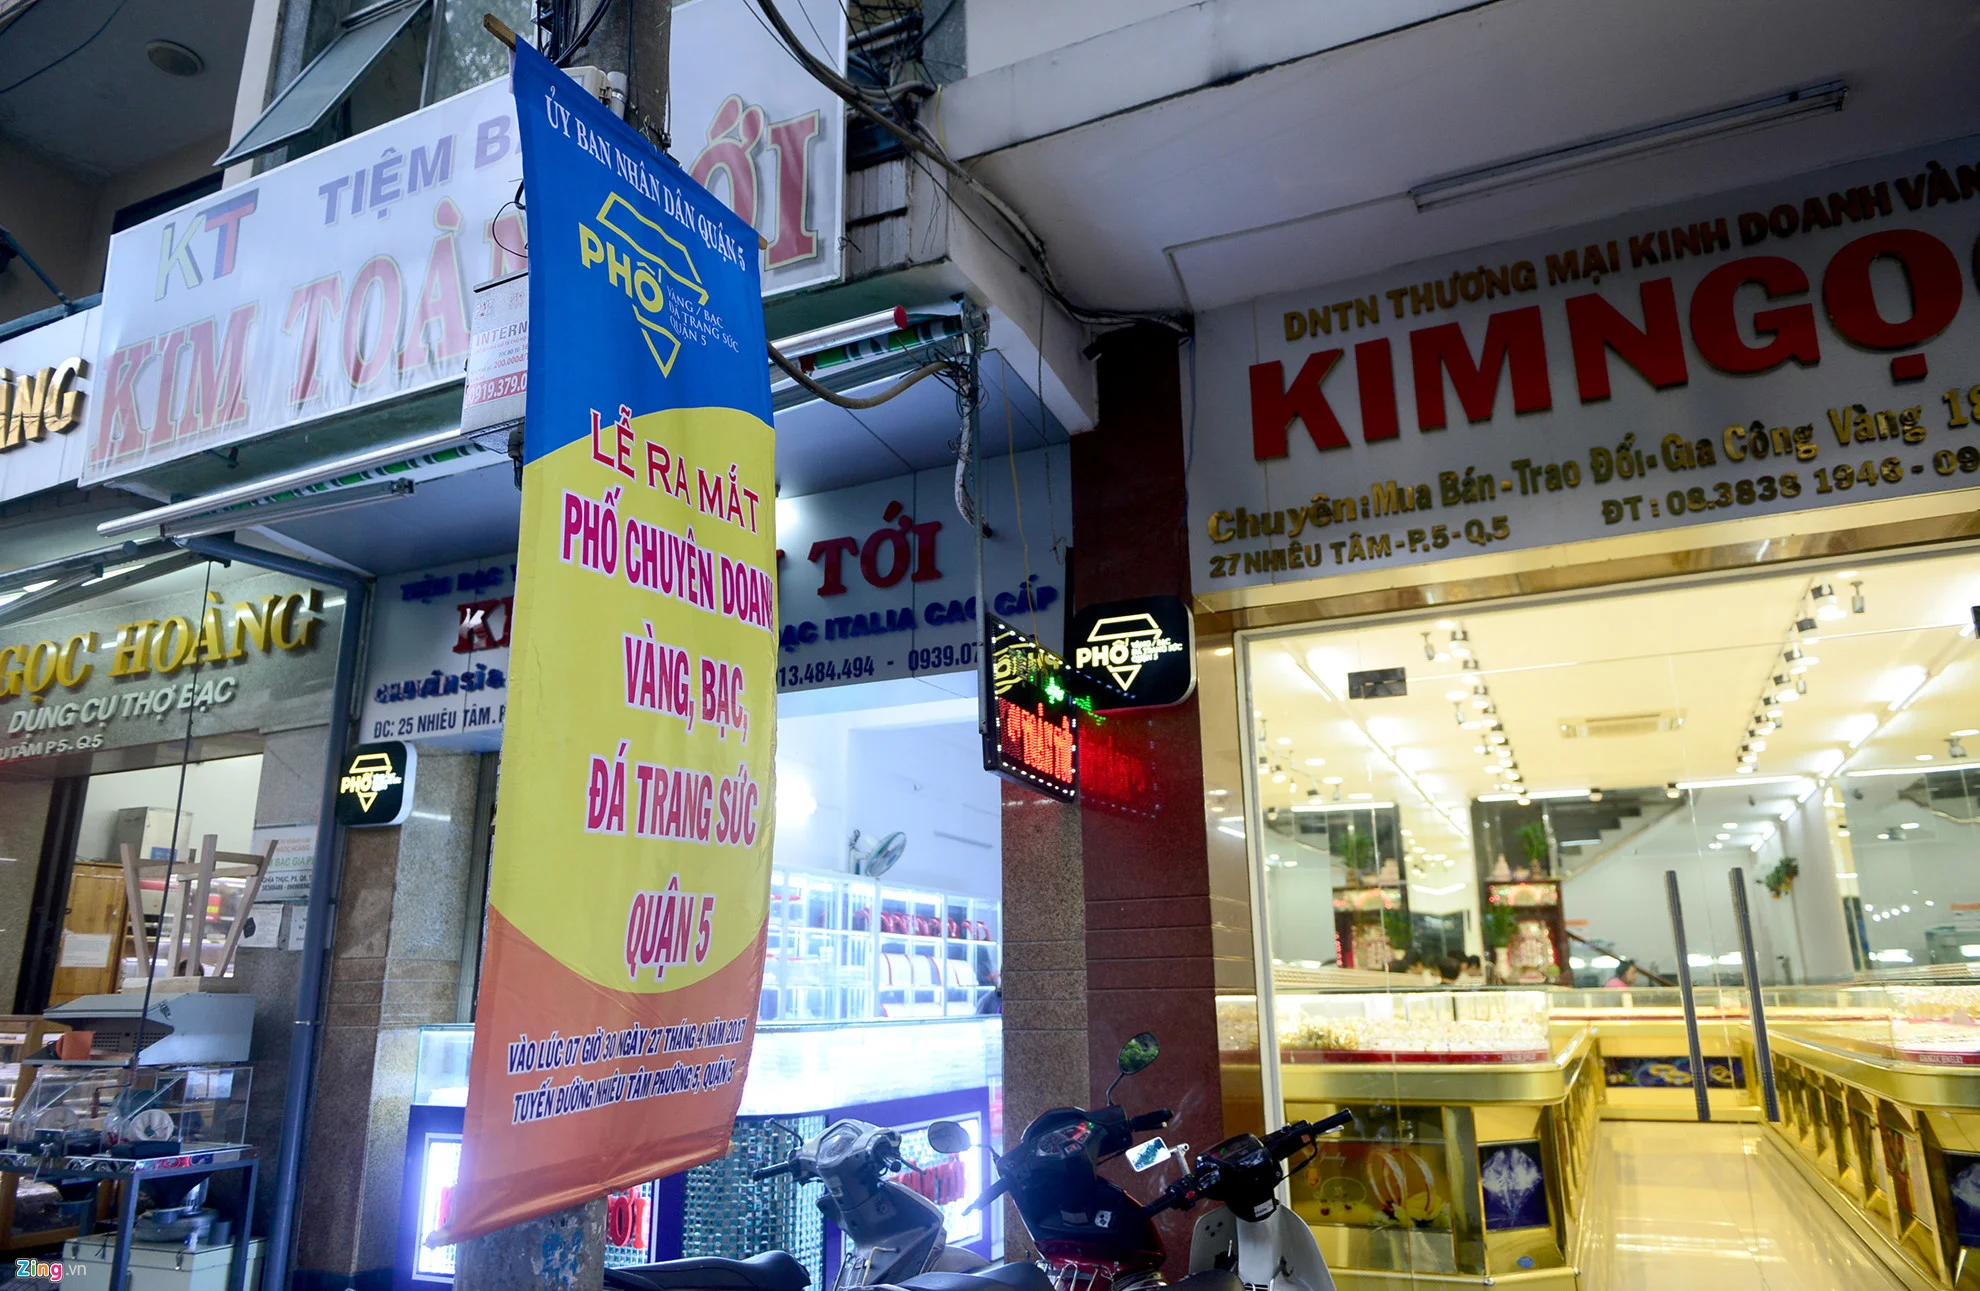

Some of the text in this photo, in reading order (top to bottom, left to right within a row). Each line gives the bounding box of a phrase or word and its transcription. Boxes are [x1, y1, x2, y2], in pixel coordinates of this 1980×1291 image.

[317, 114, 522, 224] TIỆM B
[545, 85, 746, 272] ỦY BAN NHÂN DÂN QUẬN 5
[155, 188, 259, 301] KT
[578, 222, 664, 314] PHỐ
[1283, 294, 1379, 341] DNTN
[1386, 259, 1539, 319] THƯƠNG
[1545, 239, 1620, 286] MẠI
[1629, 217, 1731, 269] KINH
[1738, 181, 1893, 249] DOANH
[666, 285, 694, 313] VÀNG
[703, 309, 724, 329] BẠC
[668, 300, 740, 353] ĐÁ TRANG SỨC
[669, 315, 707, 346] QUẬN 5
[88, 301, 258, 467] KIM
[590, 404, 760, 535] LỄ RA MẮT
[1722, 419, 1819, 462] Công
[1828, 403, 1928, 446] Vàng
[1665, 471, 1802, 516] 08.3838
[1813, 456, 1904, 495] 1946
[560, 481, 625, 578] PHỐ
[623, 517, 717, 614] CHUYÊN
[807, 500, 943, 597] TỚI
[107, 588, 323, 680] HOÀNG
[779, 621, 819, 653] ẠC
[825, 608, 917, 641] ITALIA
[994, 574, 1059, 616] CẤP
[1075, 637, 1130, 669] PHỐ
[7, 676, 238, 739] DỤNG CỤ THỢ BẠC
[622, 618, 748, 746] VÀNG, BẠC,
[776, 655, 875, 689] 13.484.494
[374, 719, 395, 739] ĐC:
[399, 717, 414, 735] 25
[417, 707, 457, 733] NHIÊU
[341, 771, 375, 794] PHỐ
[584, 738, 758, 849] ĐÁ TRANG SỨC
[624, 872, 717, 982] QUẬN 5
[508, 1016, 748, 1075] VÀO LÚC 07 GIỜ 30 NGÀY 27 THÁNG 4 NĂM 2017
[511, 1054, 737, 1126] TUYẾN ĐƯỜNG NHIÊU TÂM PHƯỜNG 5, QUẬN 5
